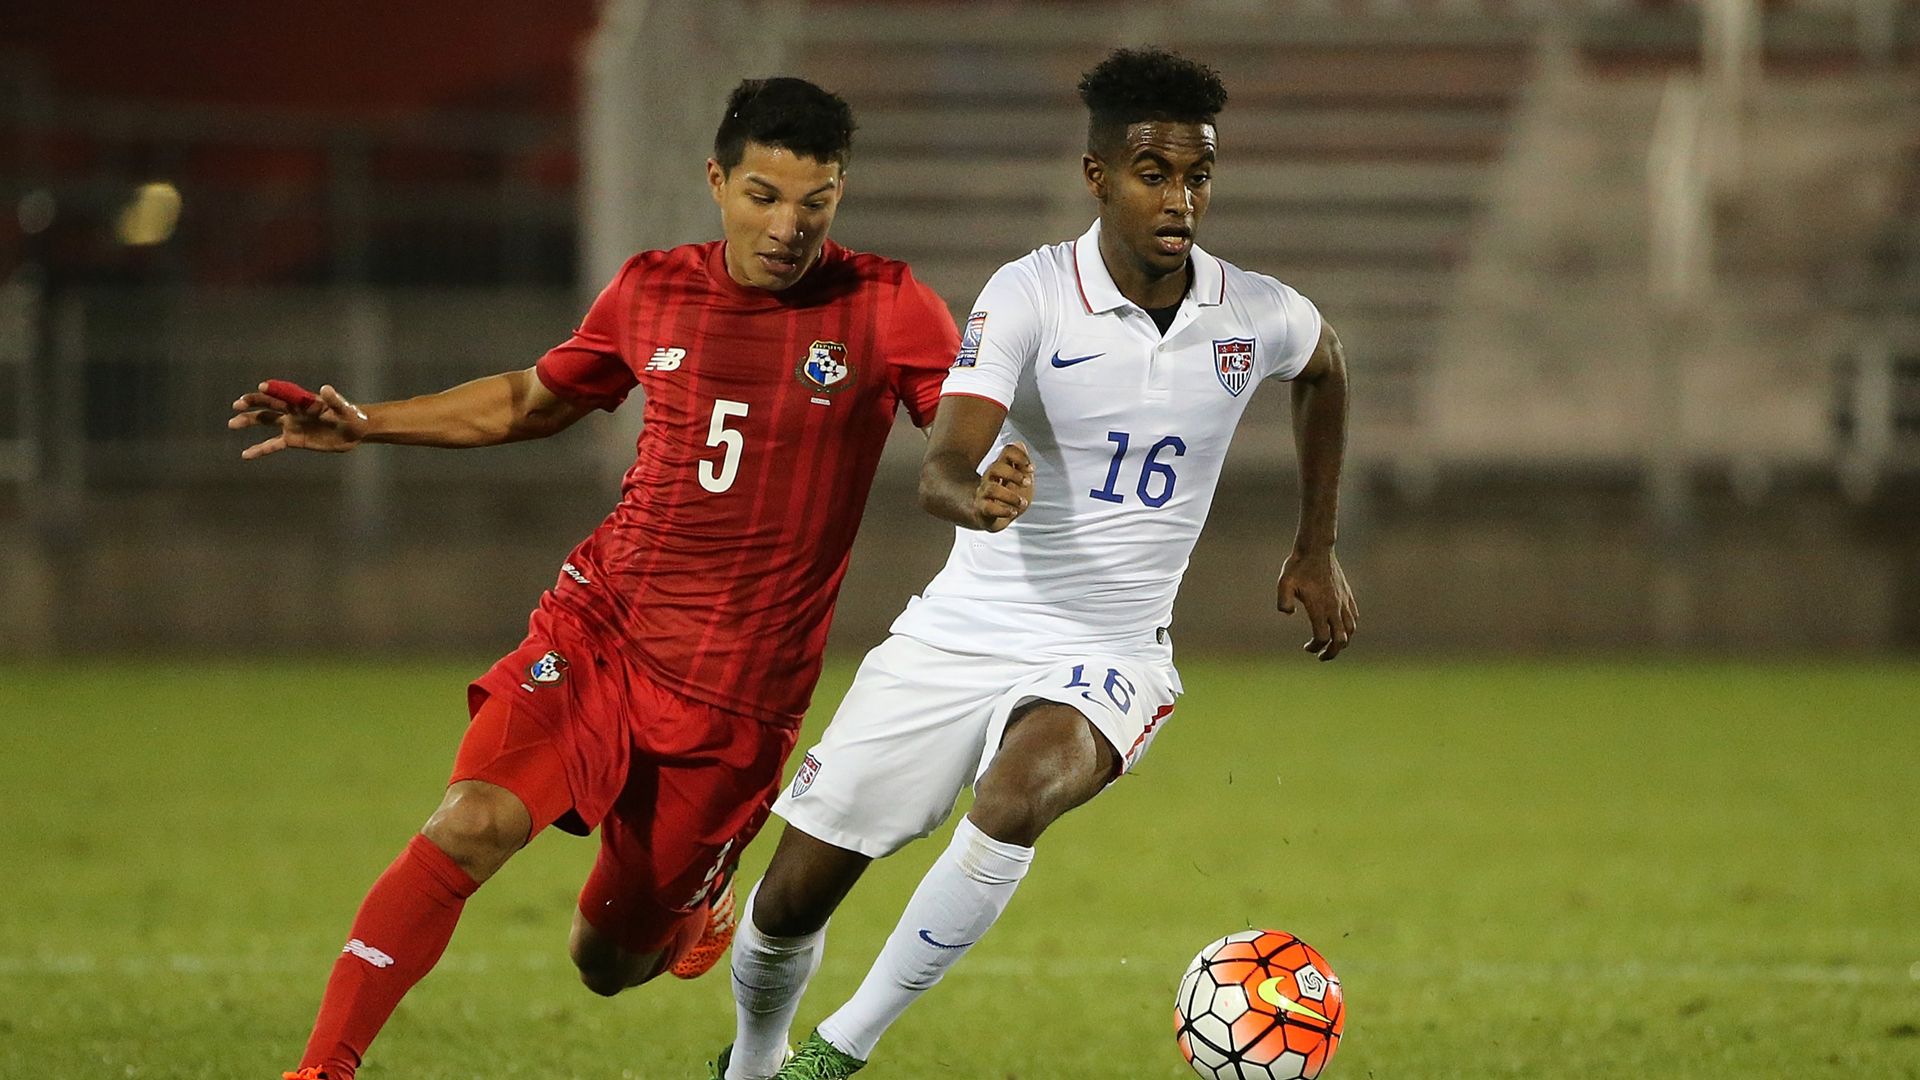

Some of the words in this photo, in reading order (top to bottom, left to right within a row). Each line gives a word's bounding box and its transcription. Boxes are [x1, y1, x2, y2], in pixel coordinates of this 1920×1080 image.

[698, 399, 750, 494] 5
[1088, 431, 1188, 509] 16
[1062, 663, 1136, 716] 16
